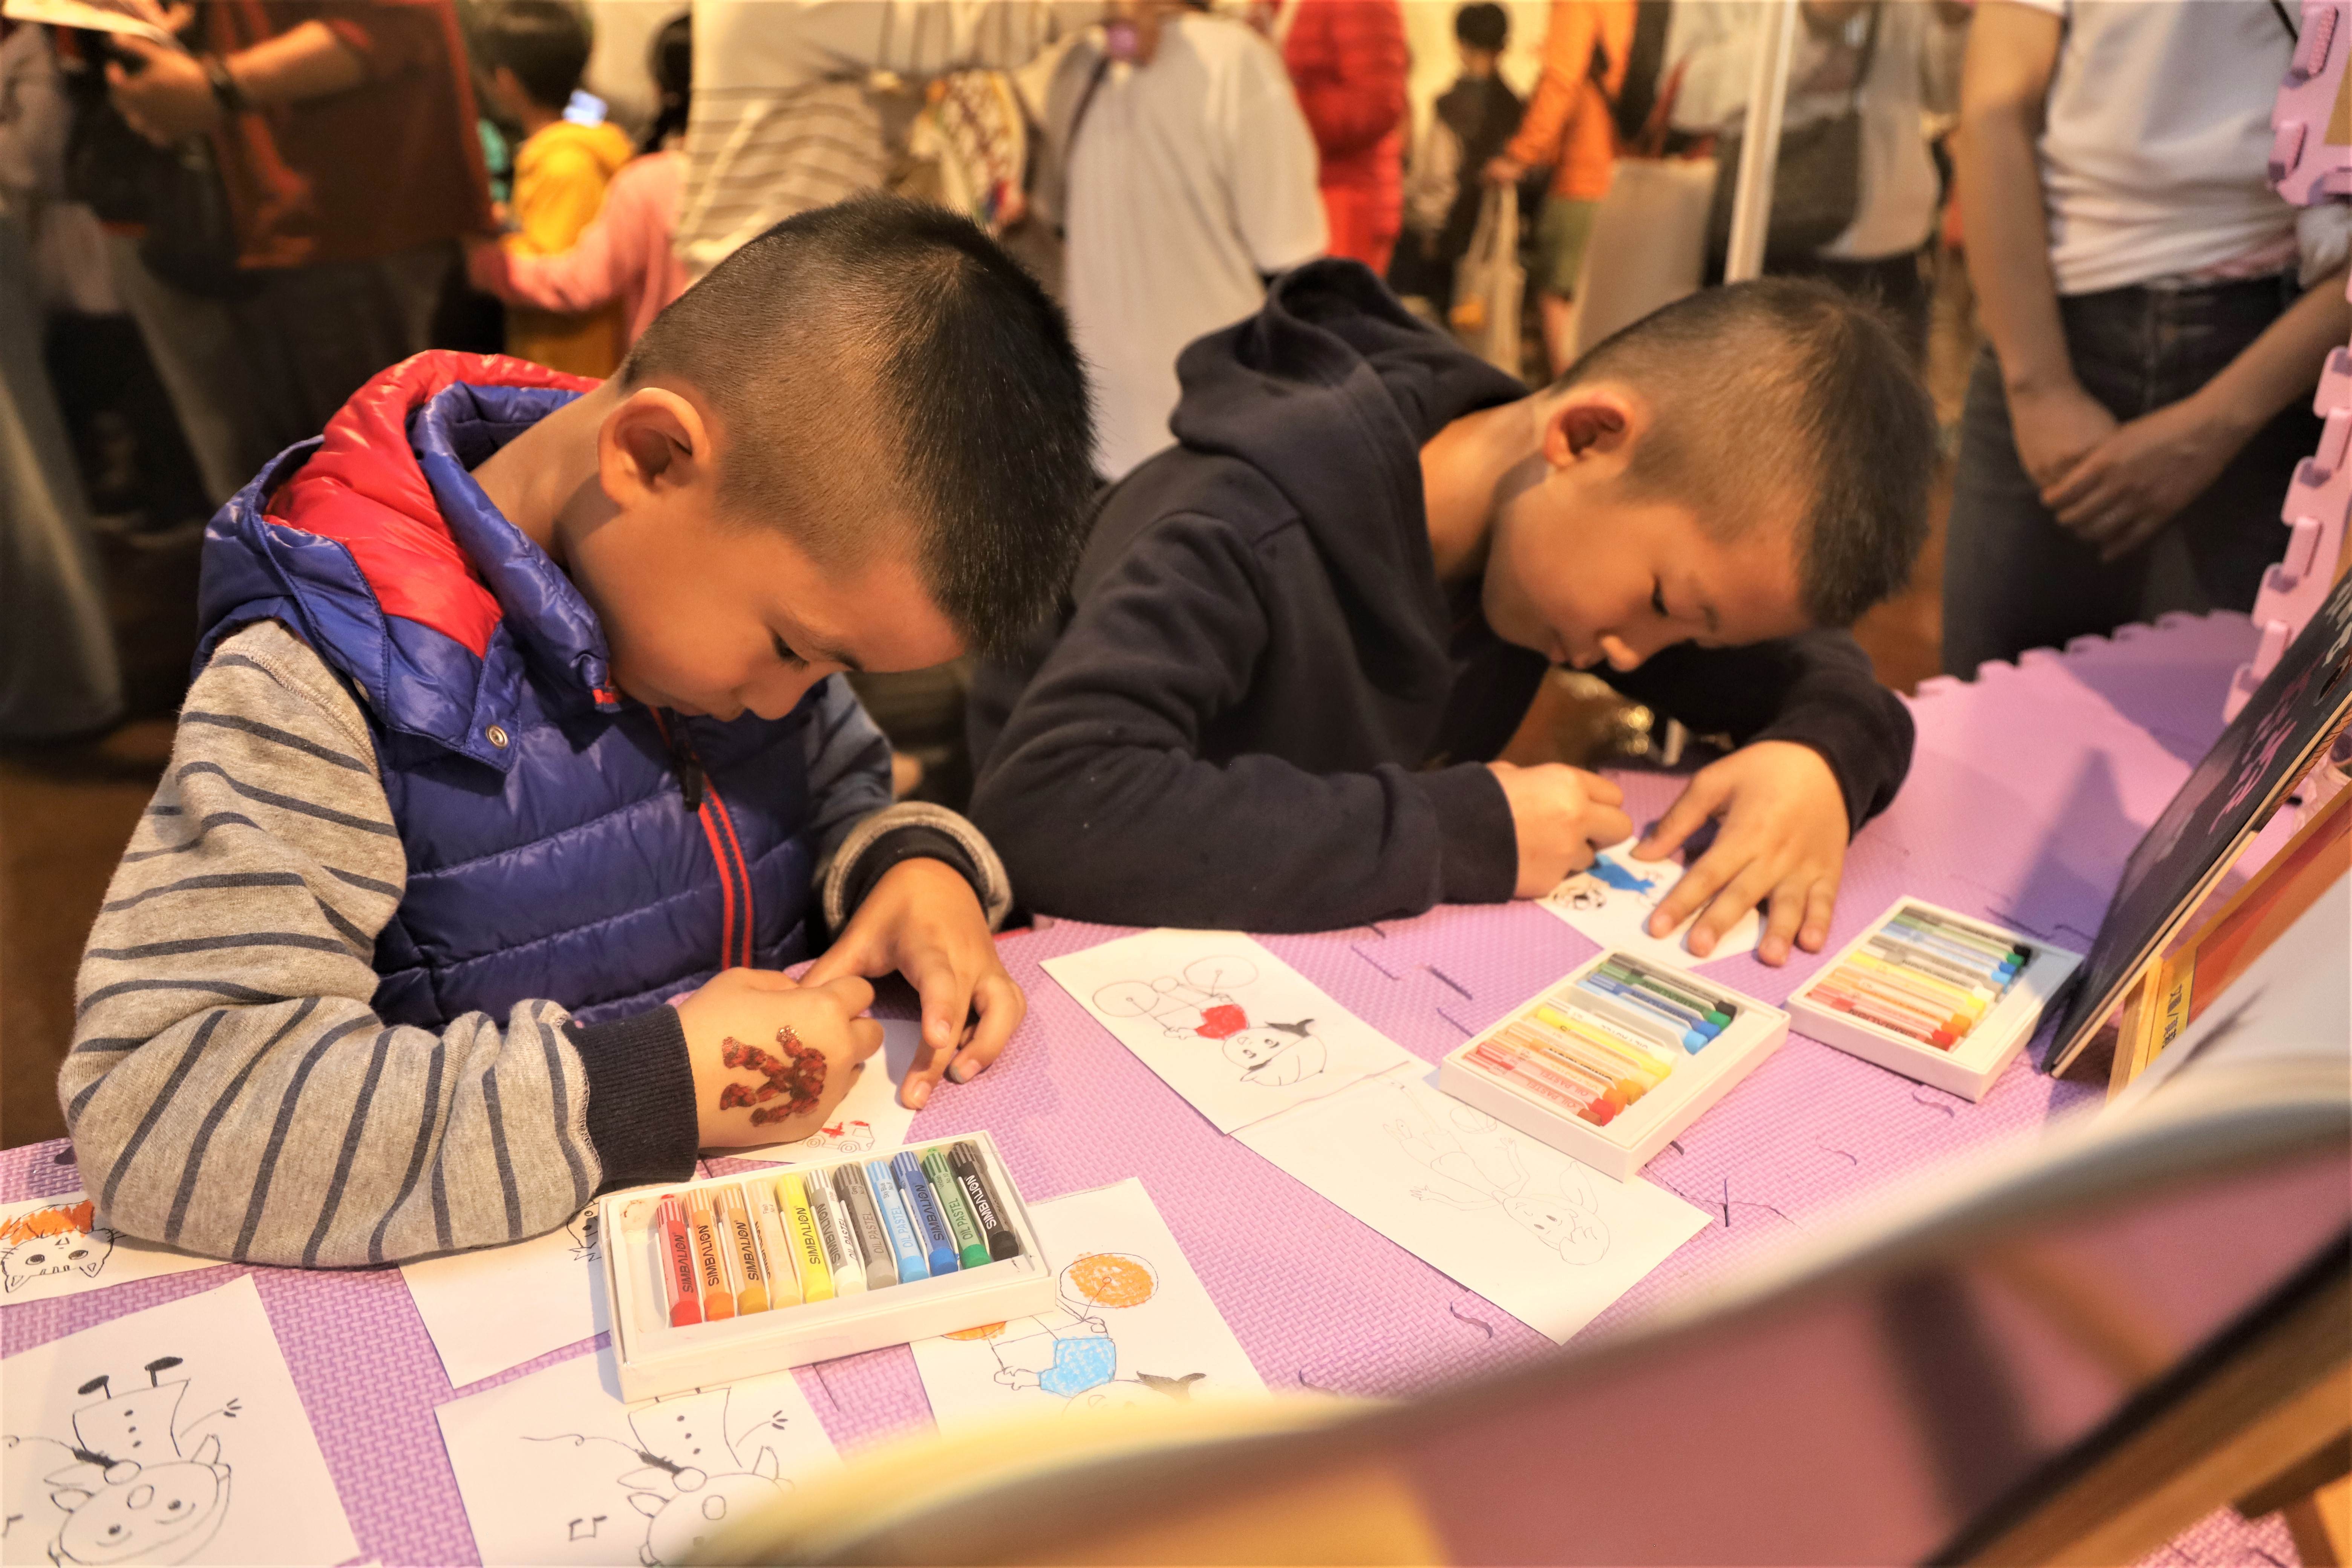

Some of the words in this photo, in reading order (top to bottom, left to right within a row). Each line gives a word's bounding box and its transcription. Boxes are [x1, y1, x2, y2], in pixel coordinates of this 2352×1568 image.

[1526, 1081, 1560, 1101] PASTEL
[1539, 1070, 1571, 1089] PASTEL
[1574, 1087, 1588, 1097] OIL
[1560, 1097, 1576, 1108] OIL
[915, 1185, 945, 1241] SIMBALION
[948, 1198, 968, 1227] PASTEL
[966, 1175, 997, 1230] SIMBALION
[817, 1203, 841, 1264] SIMBALION
[862, 1212, 880, 1240] PASTEL
[891, 1206, 908, 1234] PASTEL
[960, 1227, 973, 1240] OIL
[795, 1207, 821, 1265] SIMBALION
[871, 1241, 884, 1254] OIL
[903, 1237, 914, 1248] OIL
[674, 1234, 694, 1293] SIMBALION
[697, 1224, 720, 1287] SIMBALION
[734, 1221, 759, 1281] SIMBALION
